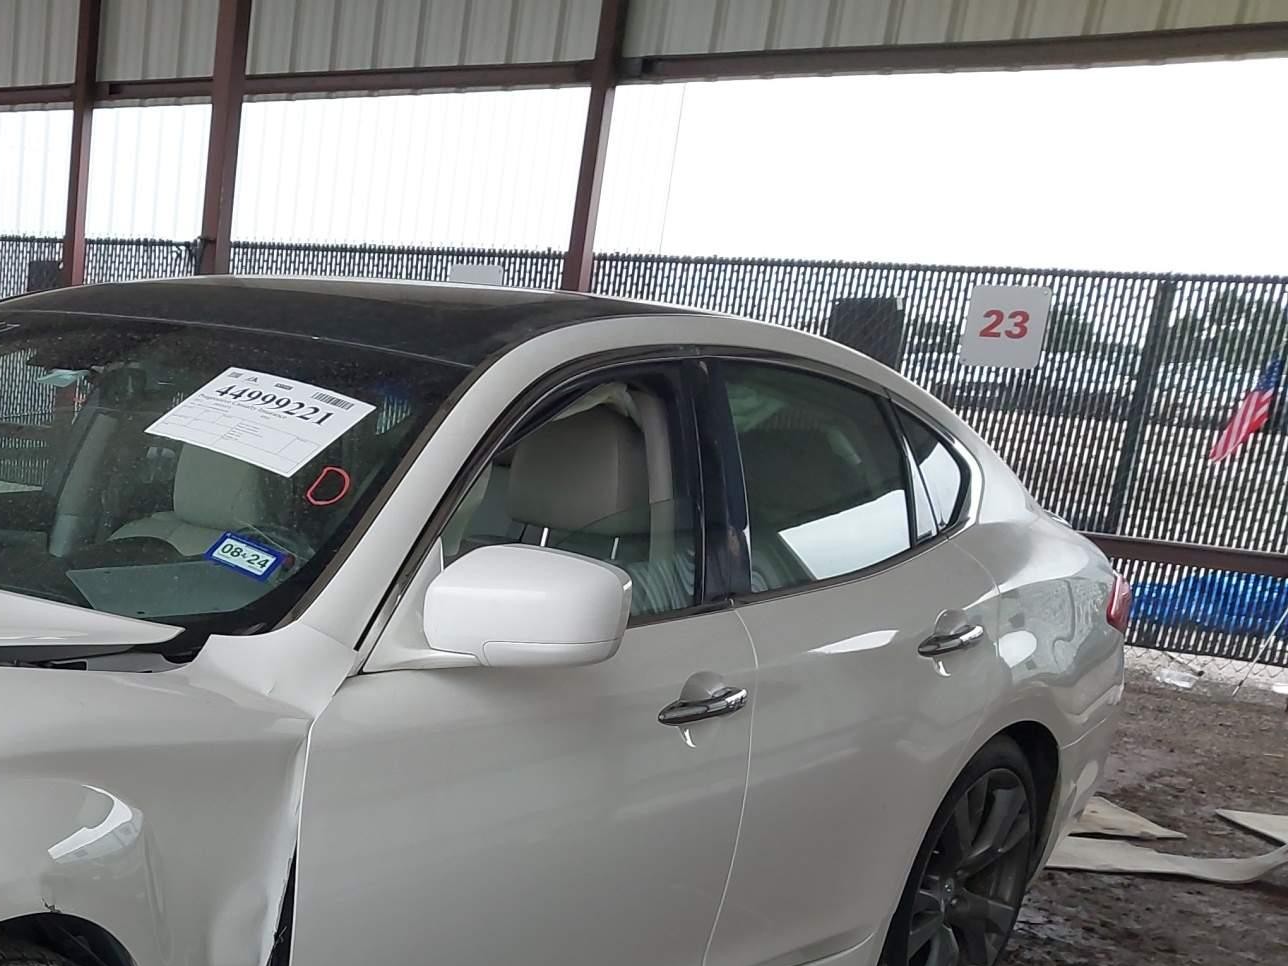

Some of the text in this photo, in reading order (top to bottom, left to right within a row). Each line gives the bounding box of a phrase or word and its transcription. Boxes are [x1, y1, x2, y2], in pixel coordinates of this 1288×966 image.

[978, 309, 1030, 339] 23
[215, 384, 334, 425] 44999221
[221, 543, 243, 557] 08
[246, 554, 269, 568] 24
